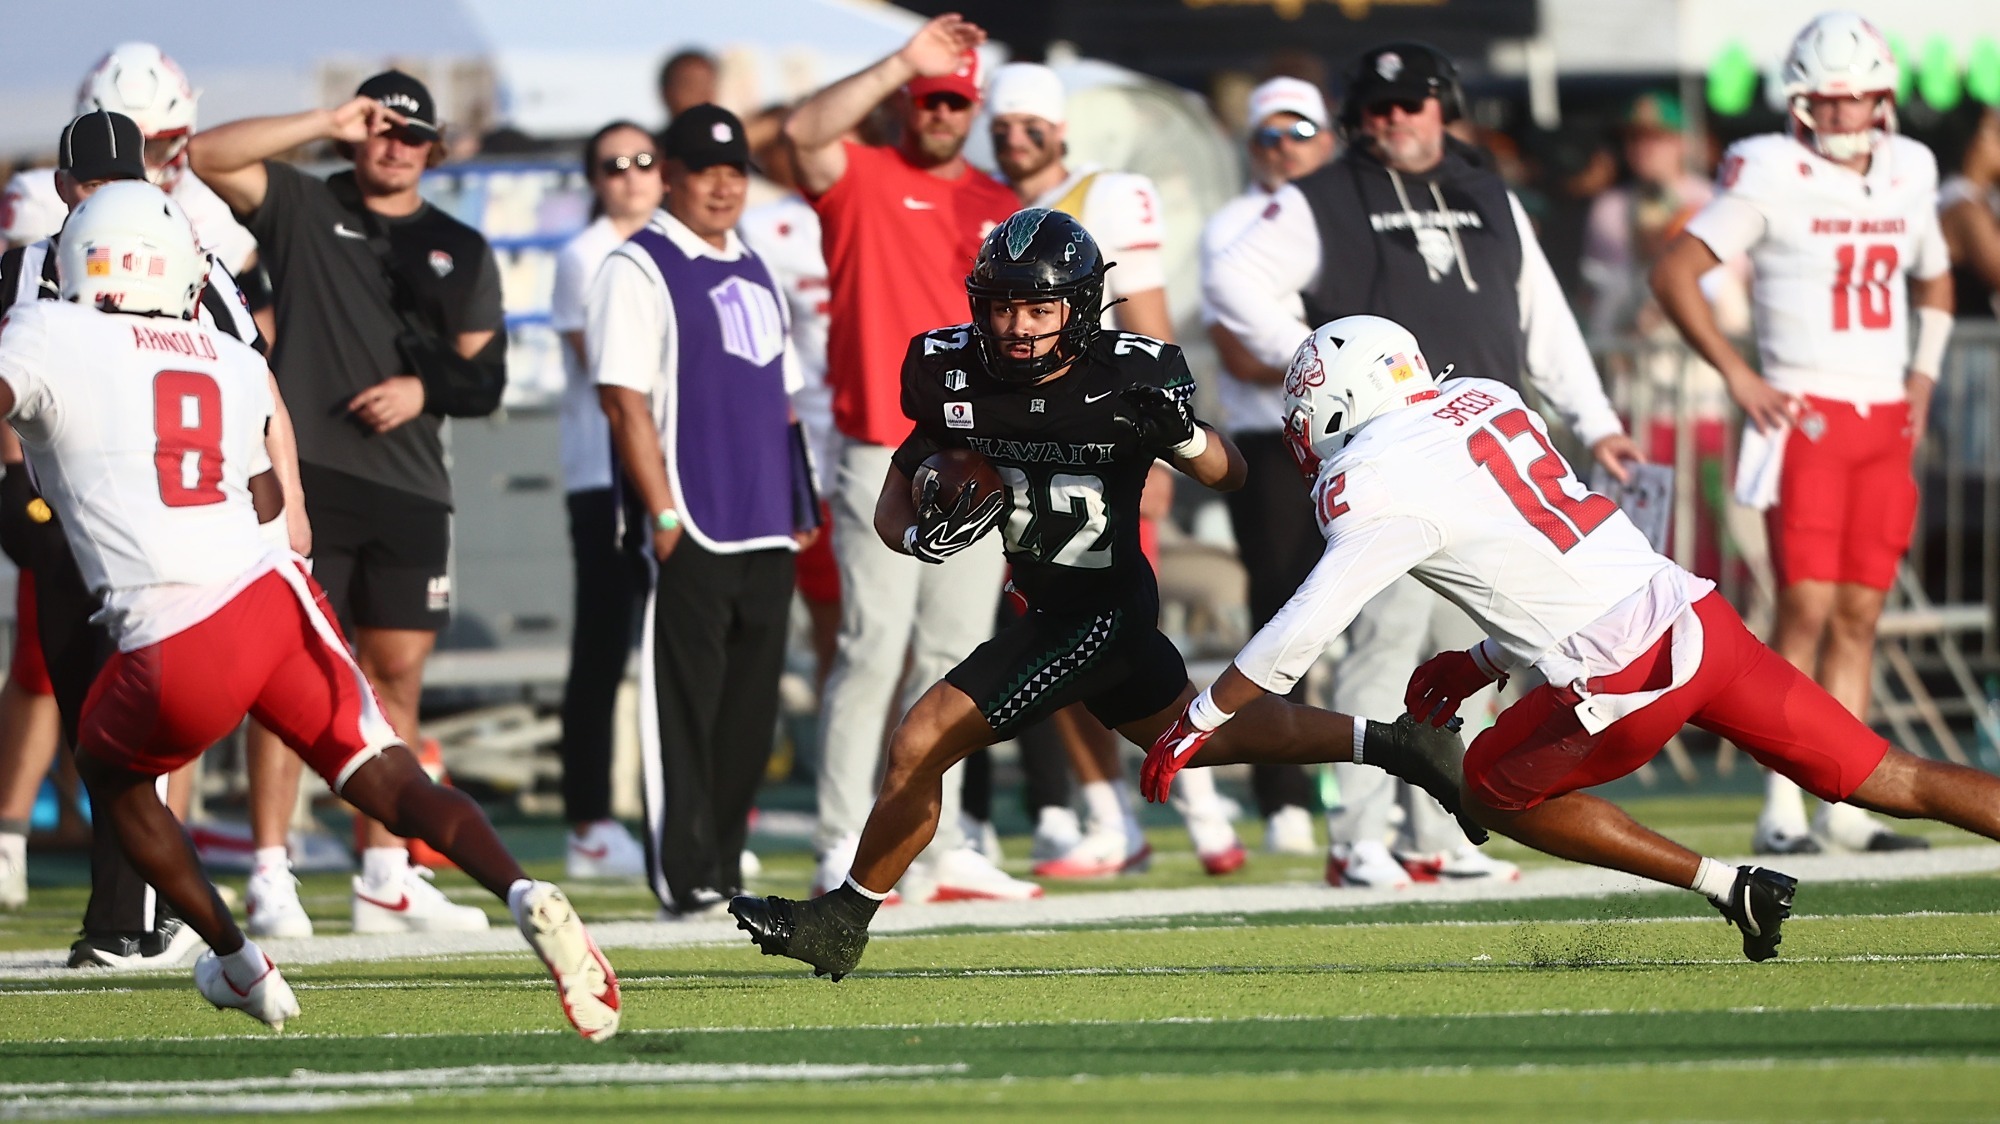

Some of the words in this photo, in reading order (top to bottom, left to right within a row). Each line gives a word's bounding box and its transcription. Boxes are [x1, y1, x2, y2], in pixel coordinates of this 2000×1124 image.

[1832, 244, 1898, 331] 10
[131, 325, 218, 361] ARNOLD
[153, 370, 228, 507] 8
[1433, 388, 1502, 427] SPEECH
[996, 465, 1113, 569] 22
[1317, 471, 1351, 527] 12
[1467, 407, 1620, 555] 12
